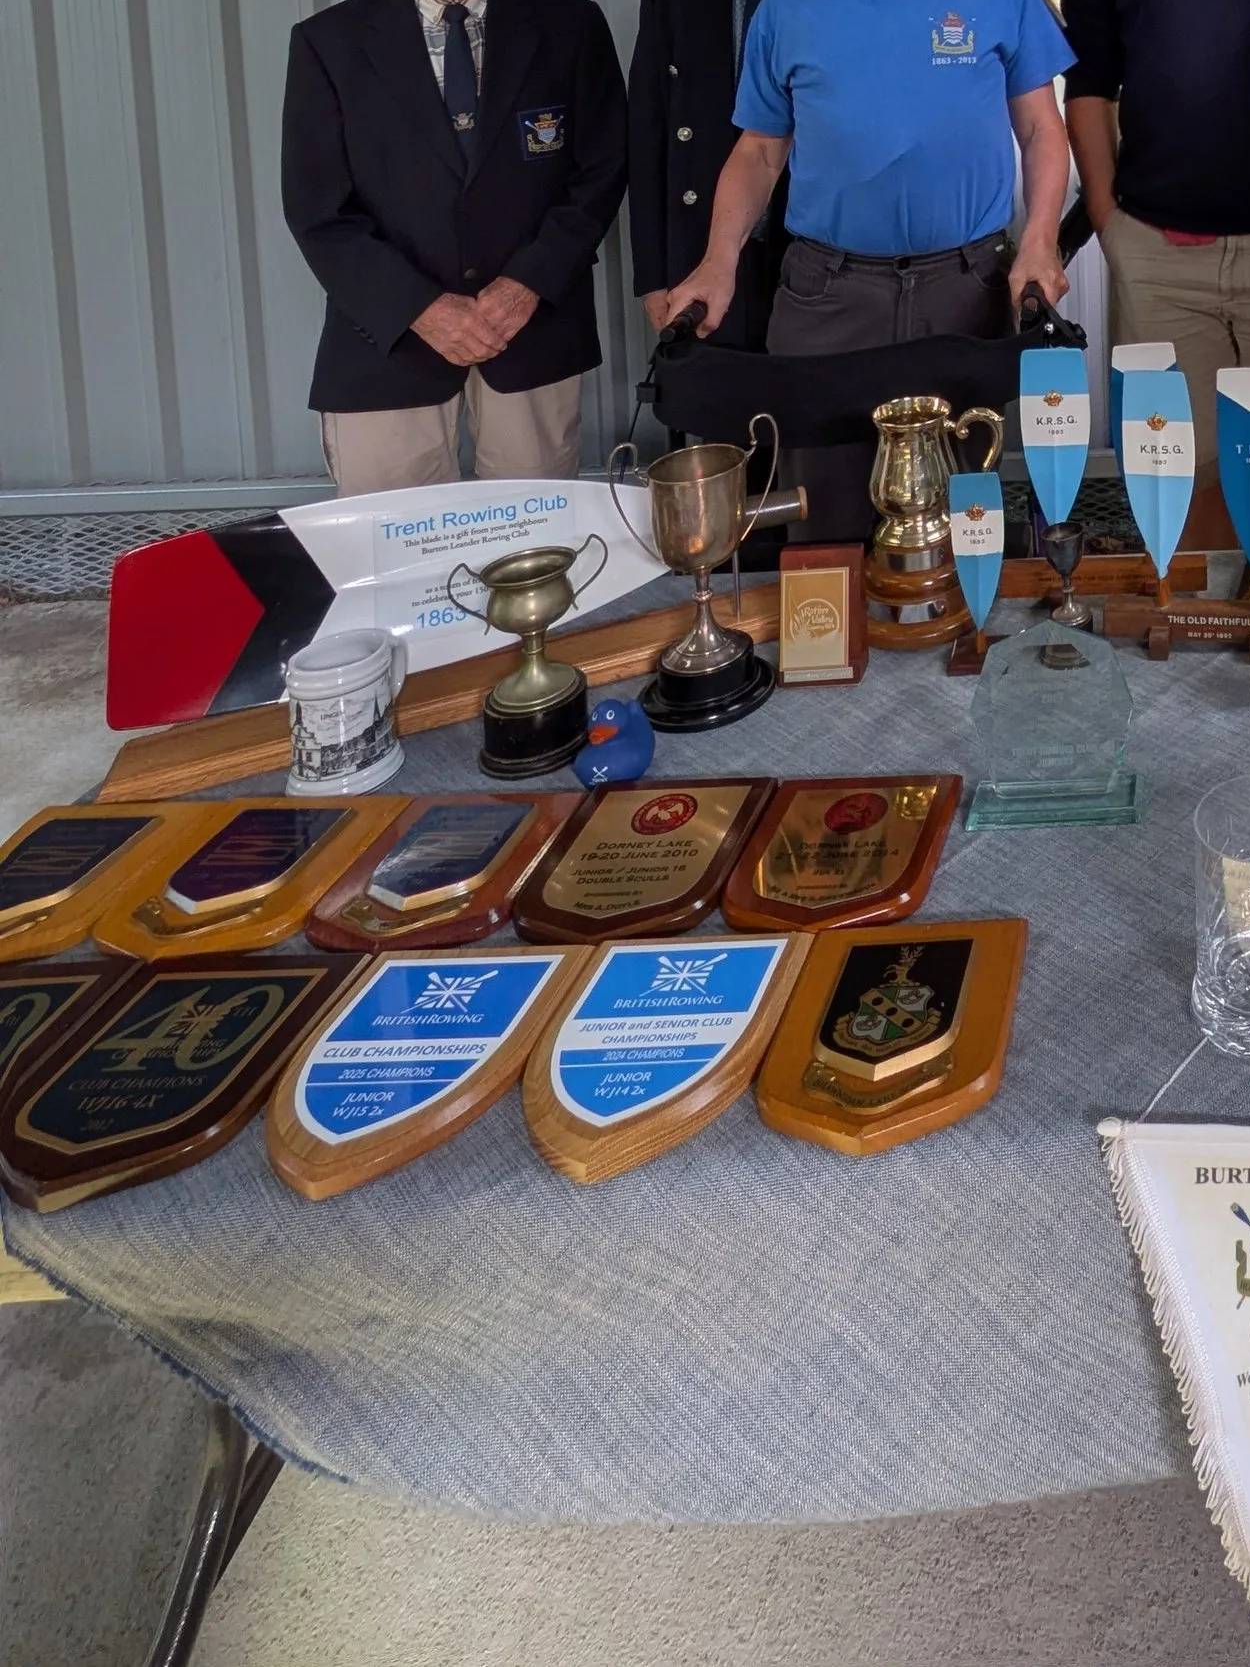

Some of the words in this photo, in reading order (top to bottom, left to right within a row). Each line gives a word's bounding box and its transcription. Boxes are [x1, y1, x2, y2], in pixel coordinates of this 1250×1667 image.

[958, 56, 977, 64] 2013
[1036, 415, 1078, 426] K.R.S.G.
[1140, 444, 1184, 454] K.R.S.G.
[381, 515, 435, 541] Trent
[442, 504, 517, 530] Rowing
[523, 494, 568, 515] Club
[404, 539, 420, 547] This
[421, 536, 442, 546] blade
[456, 529, 469, 541] gift
[470, 527, 489, 536] from
[490, 525, 507, 535] your
[508, 516, 548, 531] neighbours
[421, 544, 448, 555] Burton
[450, 538, 480, 550] Leander
[482, 533, 511, 546] Rowing
[512, 530, 530, 540] Club
[455, 590, 473, 601] your
[417, 606, 467, 629] 1863
[1168, 615, 1186, 624] THE
[1187, 615, 1207, 626] OLD
[596, 841, 653, 850] DORNEY
[656, 840, 695, 848] LAKE
[621, 851, 658, 860] JUNE
[661, 849, 699, 858] 2010
[571, 868, 614, 876] JUNIOR
[625, 865, 669, 874] JUNIOR
[576, 877, 624, 885] DOUBLE
[625, 875, 670, 883] SCULLS
[580, 1022, 627, 1032] JUNIOR
[628, 1020, 650, 1030] and
[653, 1019, 700, 1029] SENIOR
[701, 1017, 733, 1027] CLUB
[601, 1032, 698, 1044] CHAMPIONSHIPS
[323, 1047, 362, 1058] CLUB
[363, 1043, 488, 1057] CHAMPIONSHIPS
[603, 1050, 626, 1061] 2024
[627, 1048, 685, 1060] CHAMPIONS
[338, 1068, 367, 1080] 2025
[367, 1066, 435, 1079] CHAMPIONS
[600, 1072, 652, 1085] JUNIOR
[110, 1075, 209, 1091] CHAMPIONS
[341, 1091, 395, 1105] JUNIOR
[593, 1086, 629, 1098] WJ14
[332, 1105, 367, 1120] WJ15
